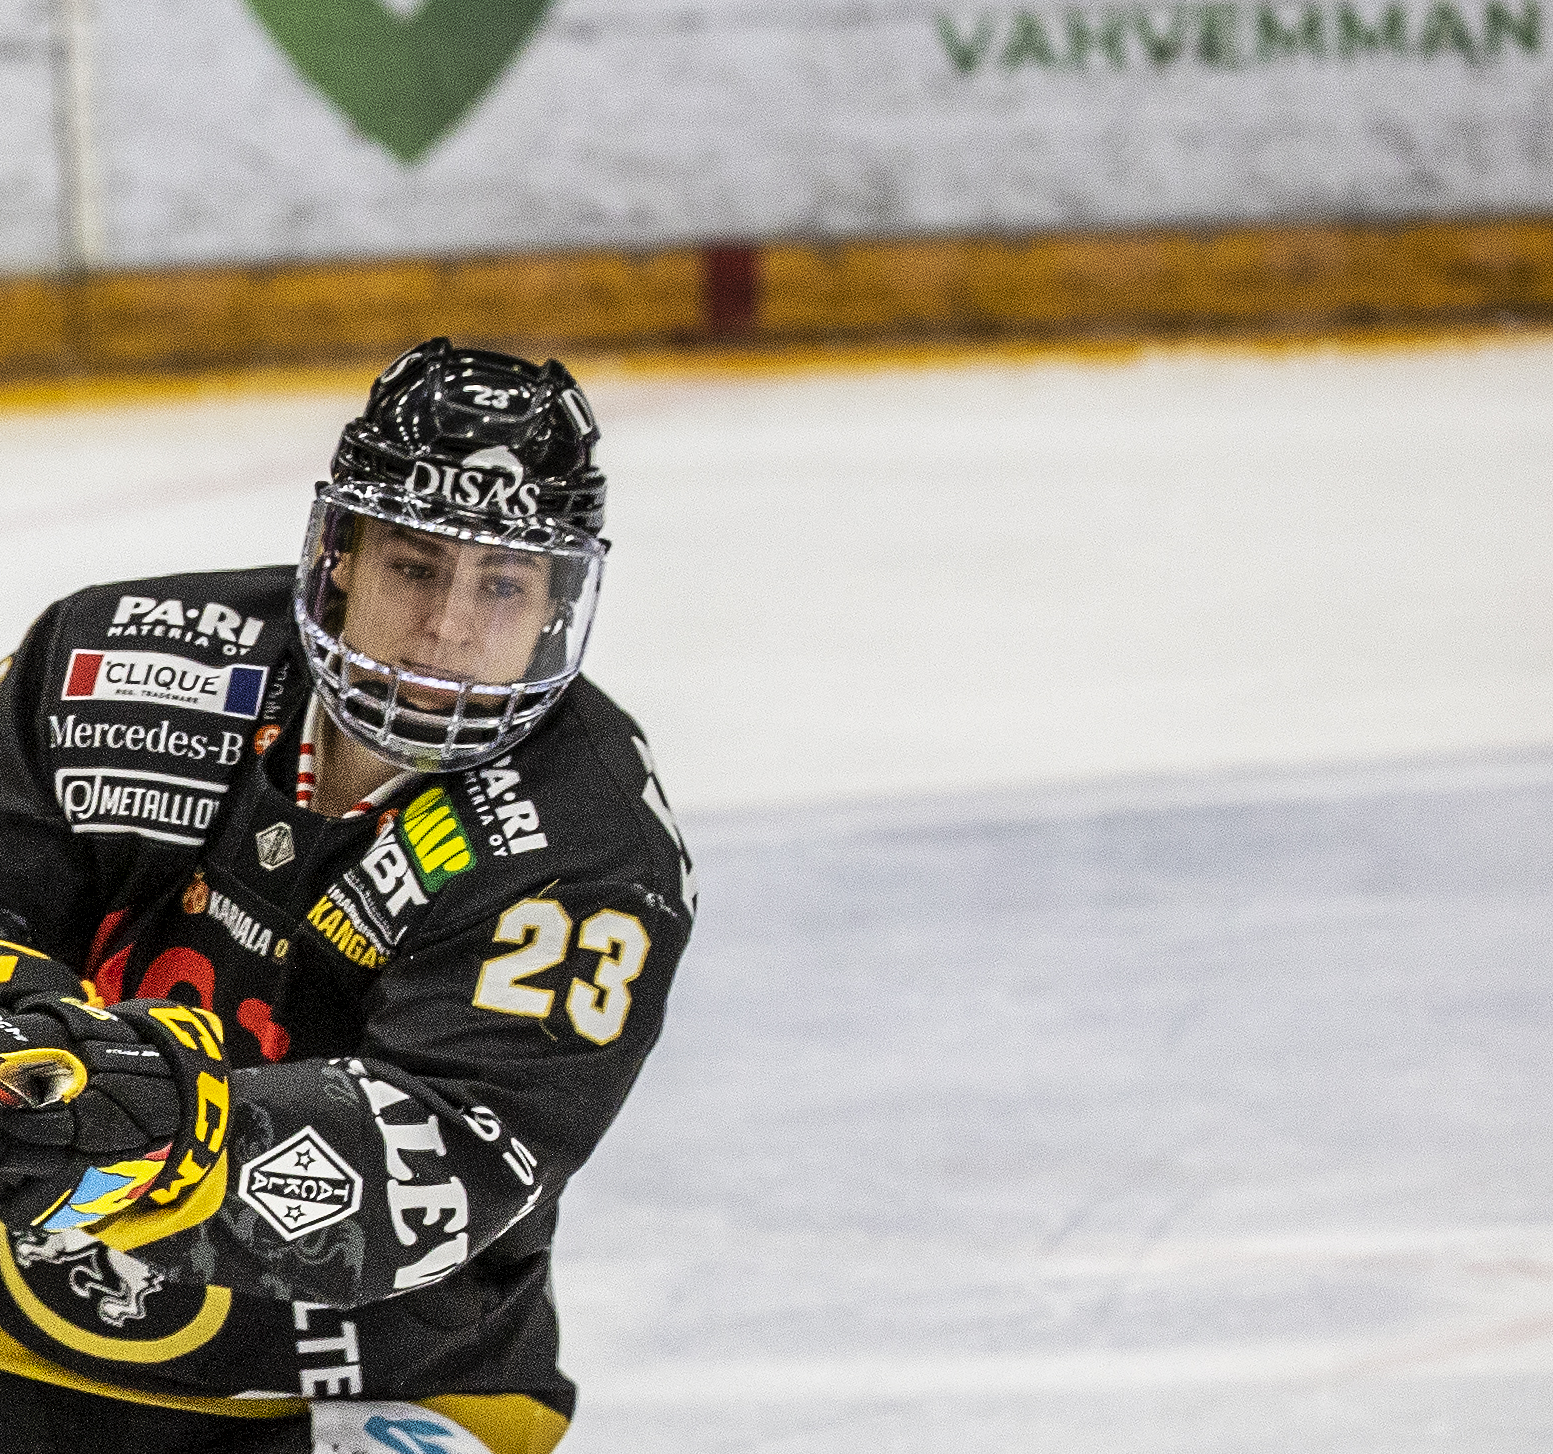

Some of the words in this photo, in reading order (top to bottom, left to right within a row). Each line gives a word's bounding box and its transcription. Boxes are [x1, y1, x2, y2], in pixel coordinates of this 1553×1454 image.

[406, 460, 542, 518] DISAS
[106, 624, 210, 648] MATERIA
[105, 661, 222, 697] CLIQUE
[473, 897, 651, 1047] 23
[251, 1171, 351, 1203] TACKLA
